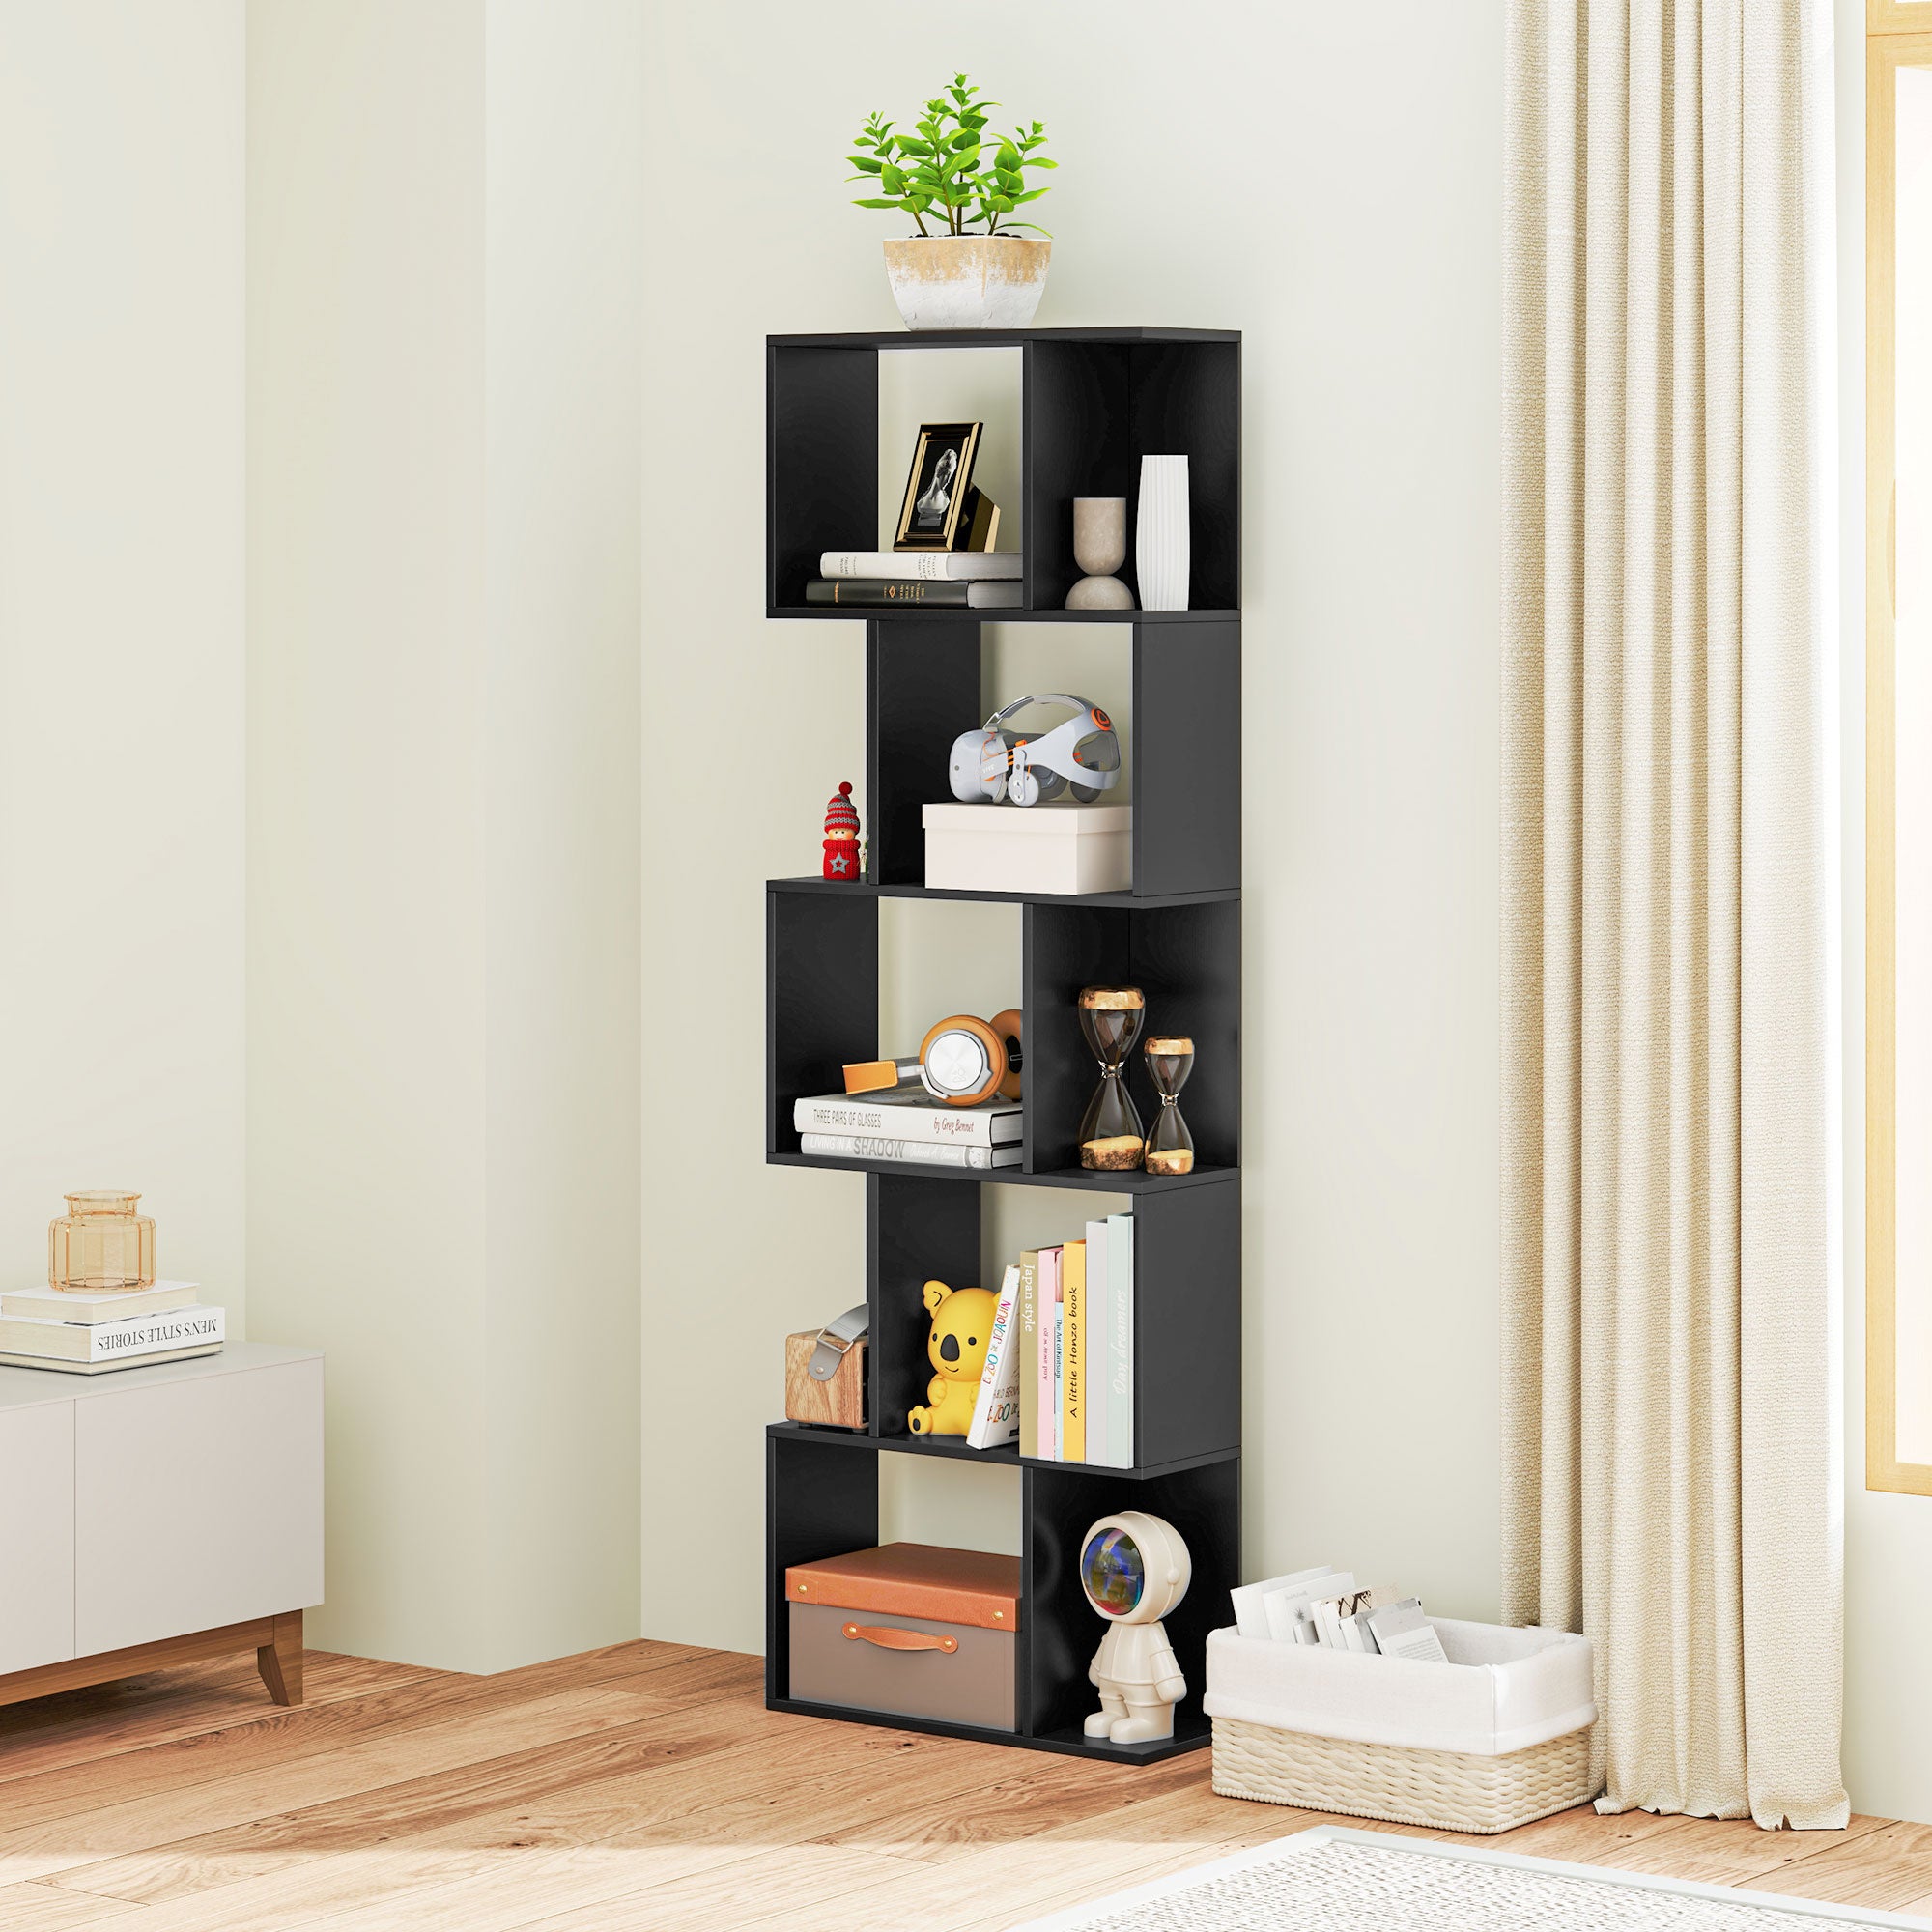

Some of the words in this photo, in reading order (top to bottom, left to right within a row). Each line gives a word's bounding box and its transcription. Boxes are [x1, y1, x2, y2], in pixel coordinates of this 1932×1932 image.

[813, 1109, 831, 1124] THREE
[832, 1110, 847, 1126] PAIRS
[849, 1111, 856, 1126] OF
[857, 1112, 882, 1128] GLASSES
[934, 1117, 940, 1134] by
[942, 1117, 954, 1135] Greg
[811, 1134, 835, 1149] LIVING
[836, 1136, 844, 1151] IN
[853, 1137, 905, 1158] SHADOW
[1022, 1264, 1036, 1299] Japan
[184, 1318, 217, 1337] MEN'S
[1022, 1303, 1036, 1332] style
[1110, 1290, 1128, 1359] dreamers
[98, 1330, 145, 1350] STORIES
[148, 1324, 182, 1342] STYLE
[1056, 1343, 1062, 1351] of
[985, 1353, 999, 1377] ZOO
[1112, 1362, 1128, 1395] Day
[1069, 1407, 1077, 1418] A
